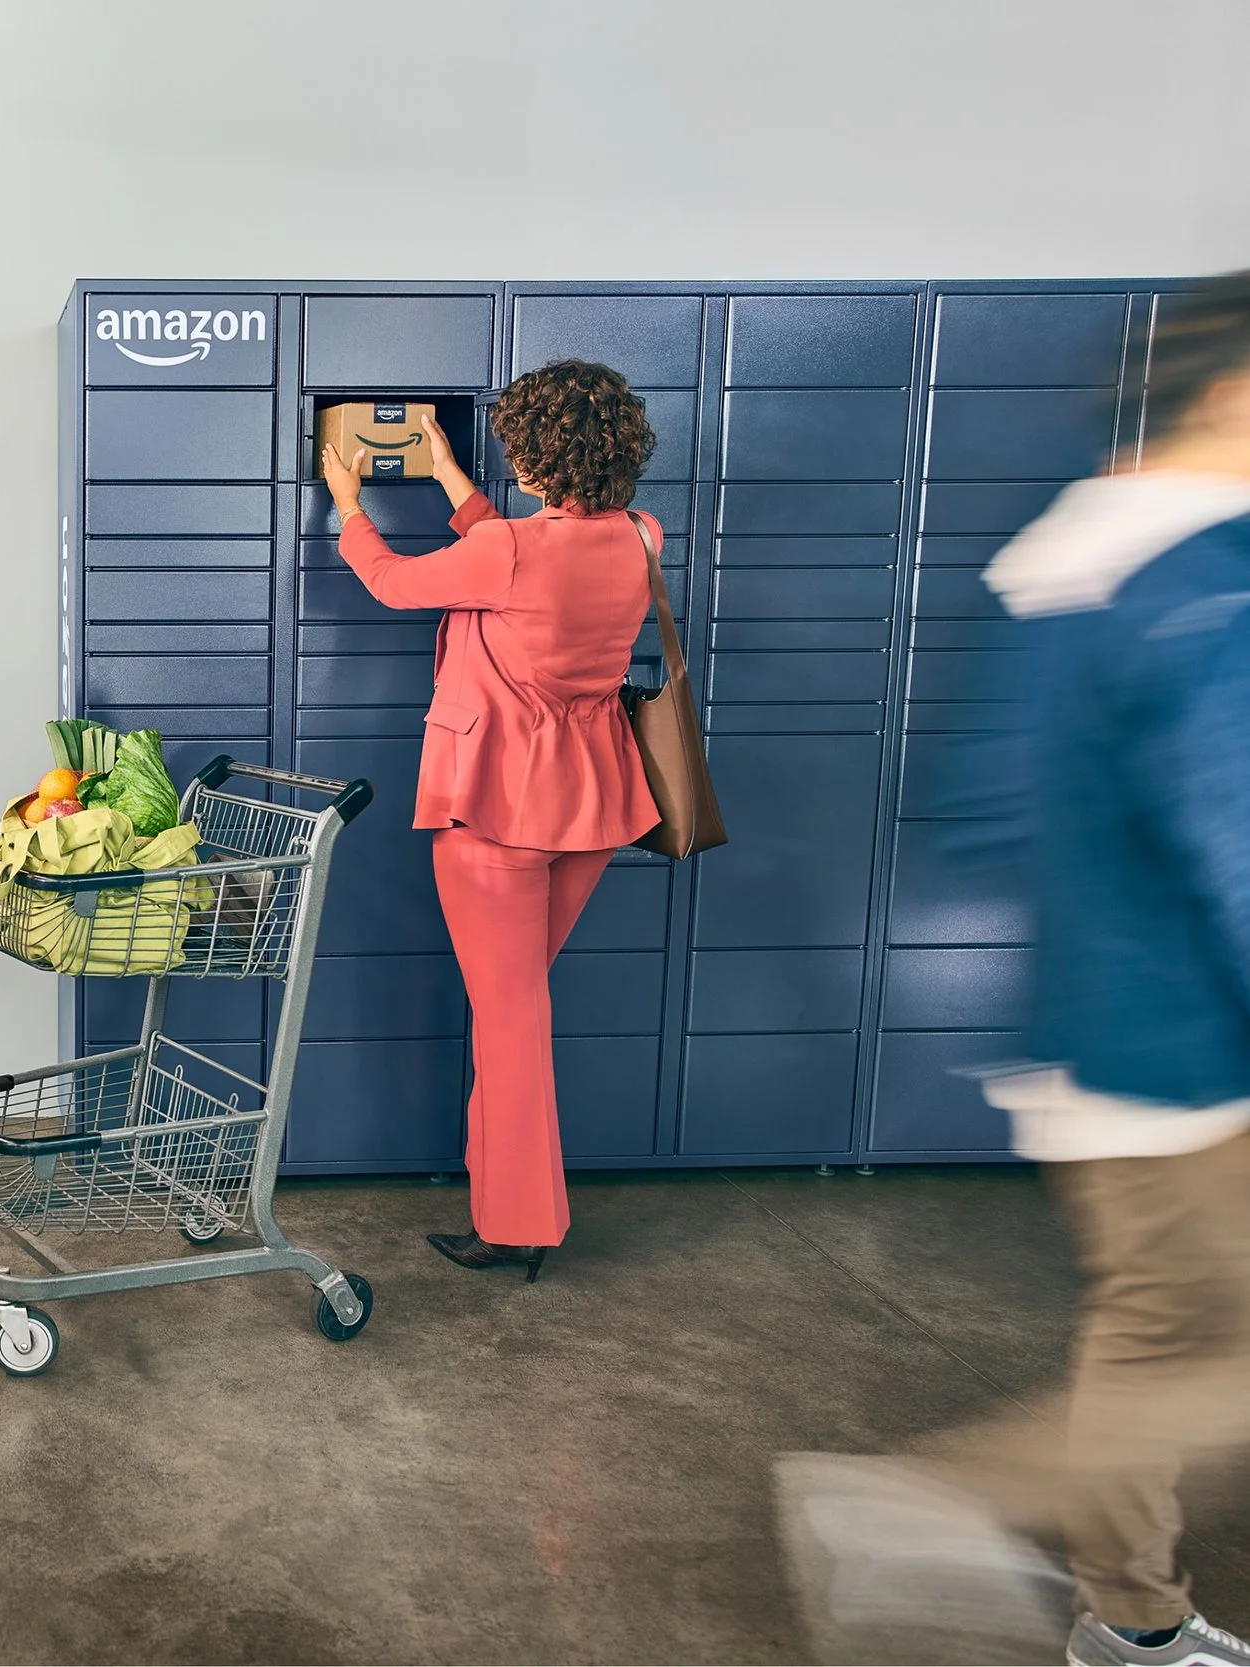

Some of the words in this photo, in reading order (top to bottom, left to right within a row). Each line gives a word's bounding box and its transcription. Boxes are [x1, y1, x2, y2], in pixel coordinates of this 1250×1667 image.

[96, 309, 266, 342] amazon
[377, 409, 403, 417] amazon
[375, 459, 401, 467] amazon
